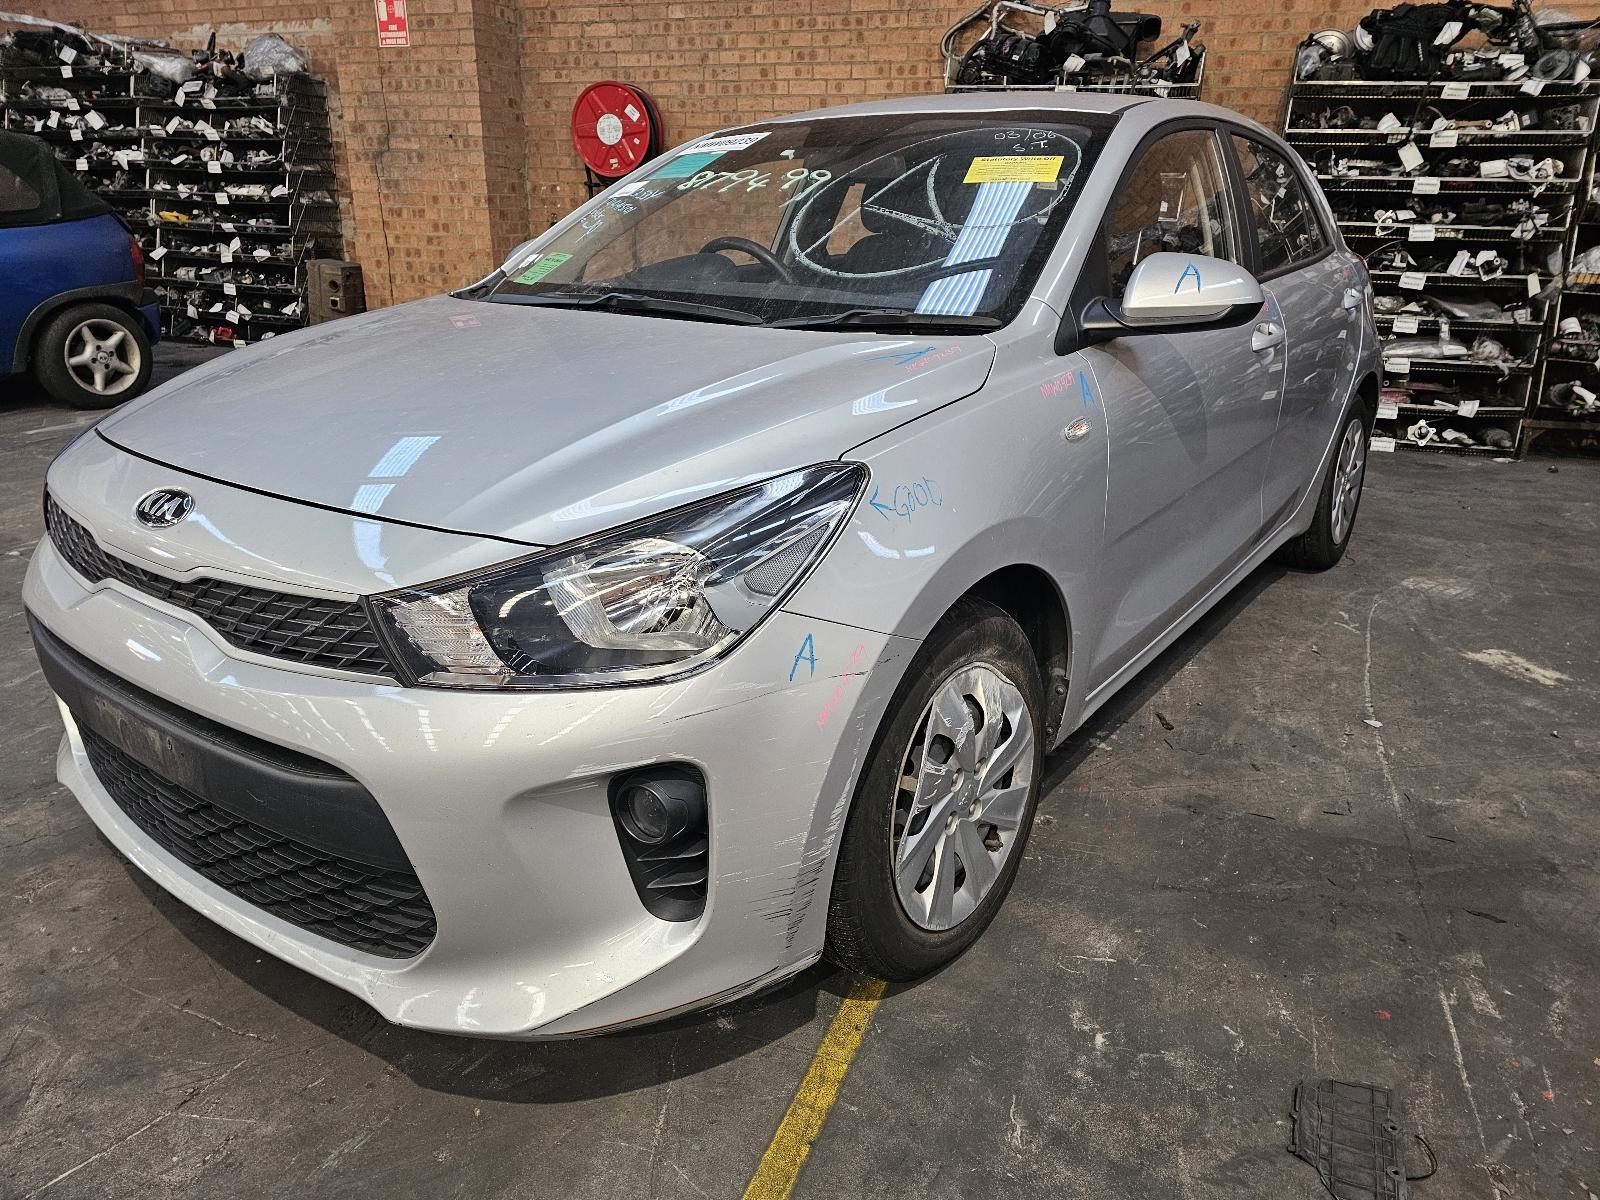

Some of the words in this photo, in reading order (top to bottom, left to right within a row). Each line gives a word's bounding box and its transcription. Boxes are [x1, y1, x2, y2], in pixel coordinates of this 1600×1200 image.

[1174, 263, 1201, 295] A
[1078, 370, 1097, 411] A
[138, 491, 183, 520] KIA
[789, 632, 815, 682] A
